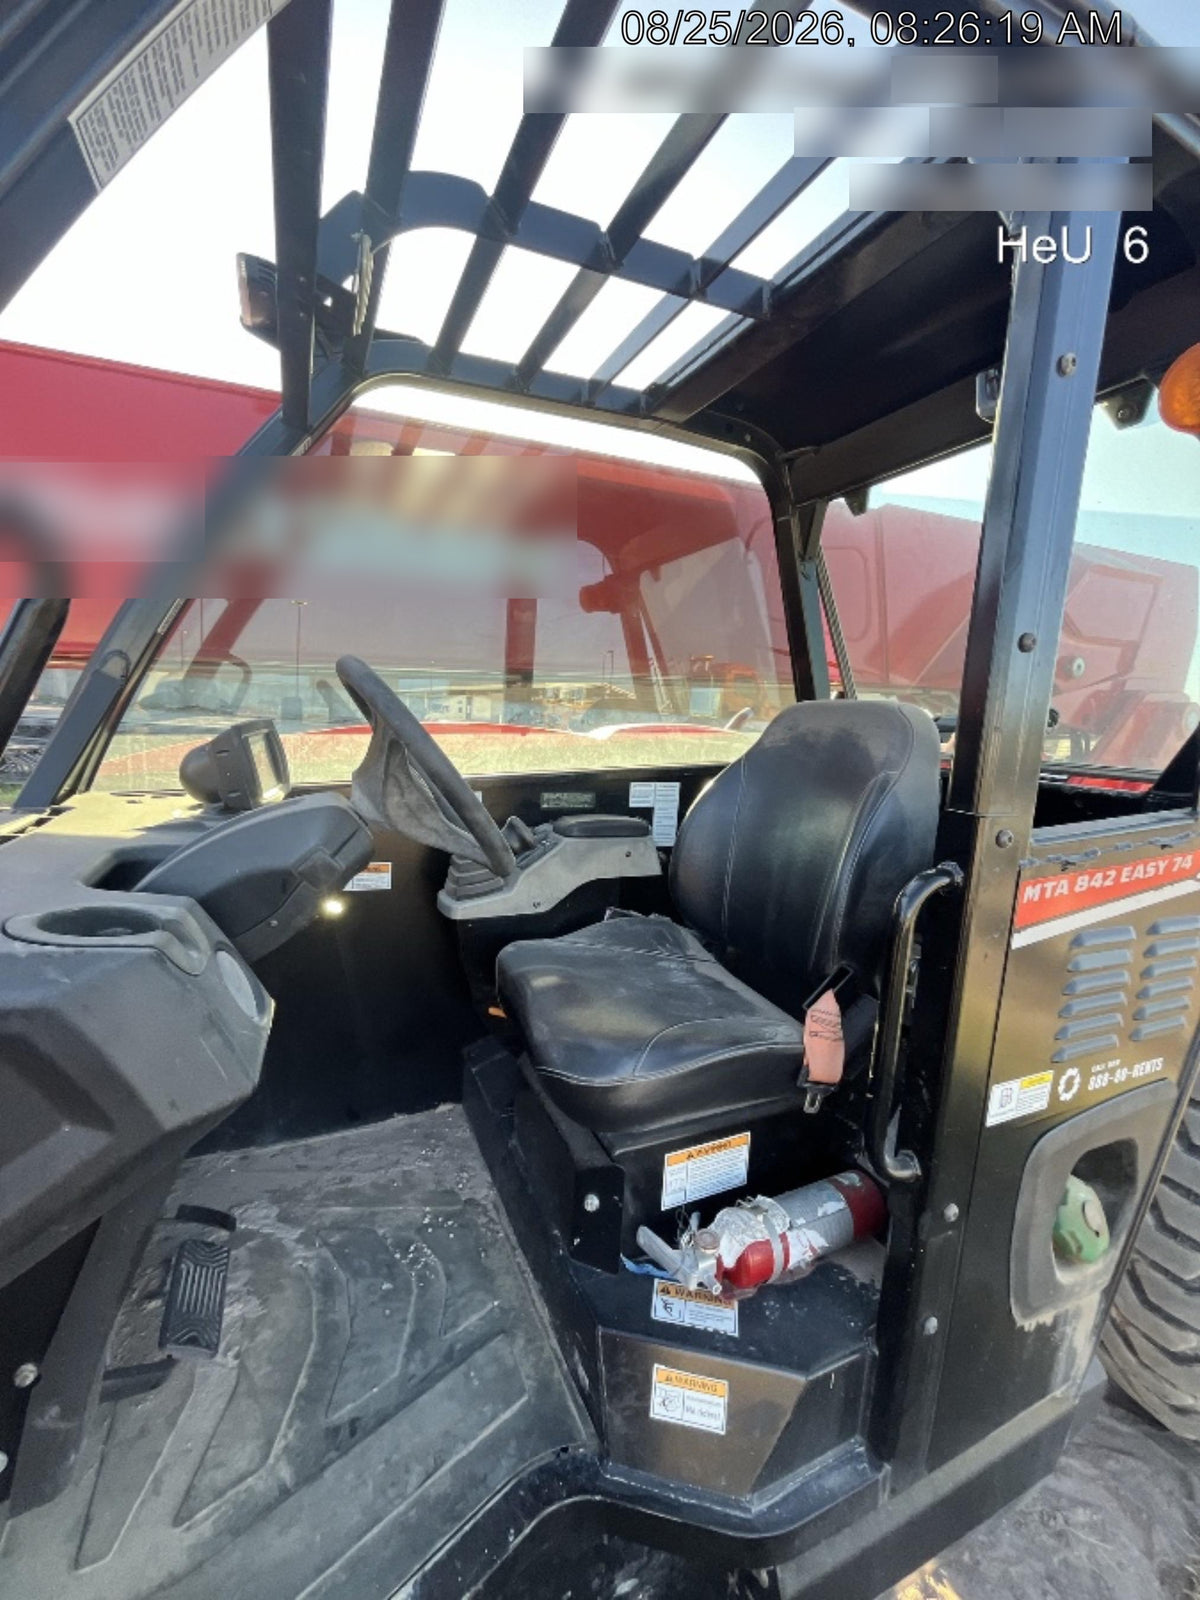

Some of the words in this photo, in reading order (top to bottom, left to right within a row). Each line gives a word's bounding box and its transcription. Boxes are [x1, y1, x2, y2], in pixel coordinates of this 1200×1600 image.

[1023, 879, 1069, 903] MTA
[1074, 869, 1117, 893] 842
[1120, 859, 1169, 883] EASY
[1172, 854, 1193, 872] 74
[675, 1287, 732, 1306] WARNING
